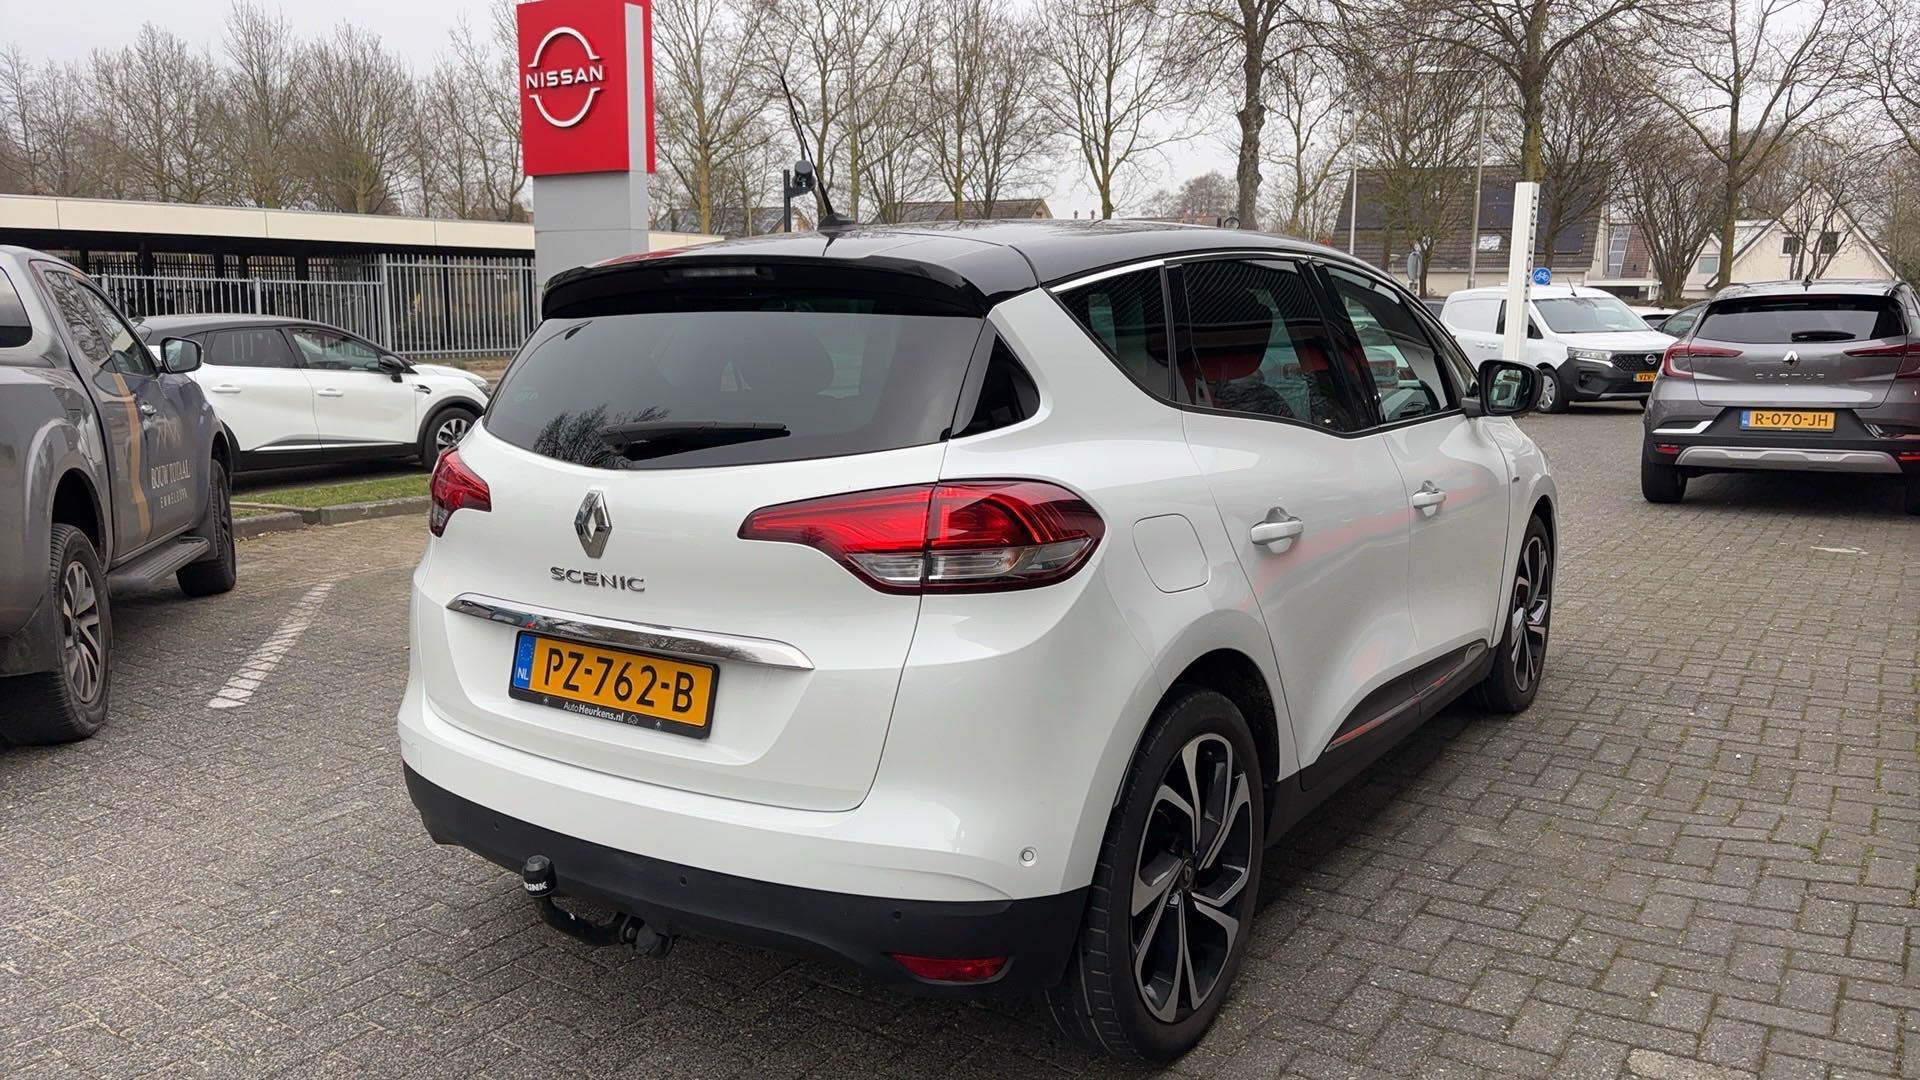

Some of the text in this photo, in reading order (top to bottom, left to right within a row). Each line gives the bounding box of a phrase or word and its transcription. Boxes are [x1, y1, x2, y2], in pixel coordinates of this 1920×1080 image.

[526, 65, 603, 89] NISSAN
[1755, 412, 1828, 427] R-070-JH
[550, 566, 645, 592] SCENIC
[517, 667, 529, 680] NL
[543, 647, 695, 713] PZ-762-B
